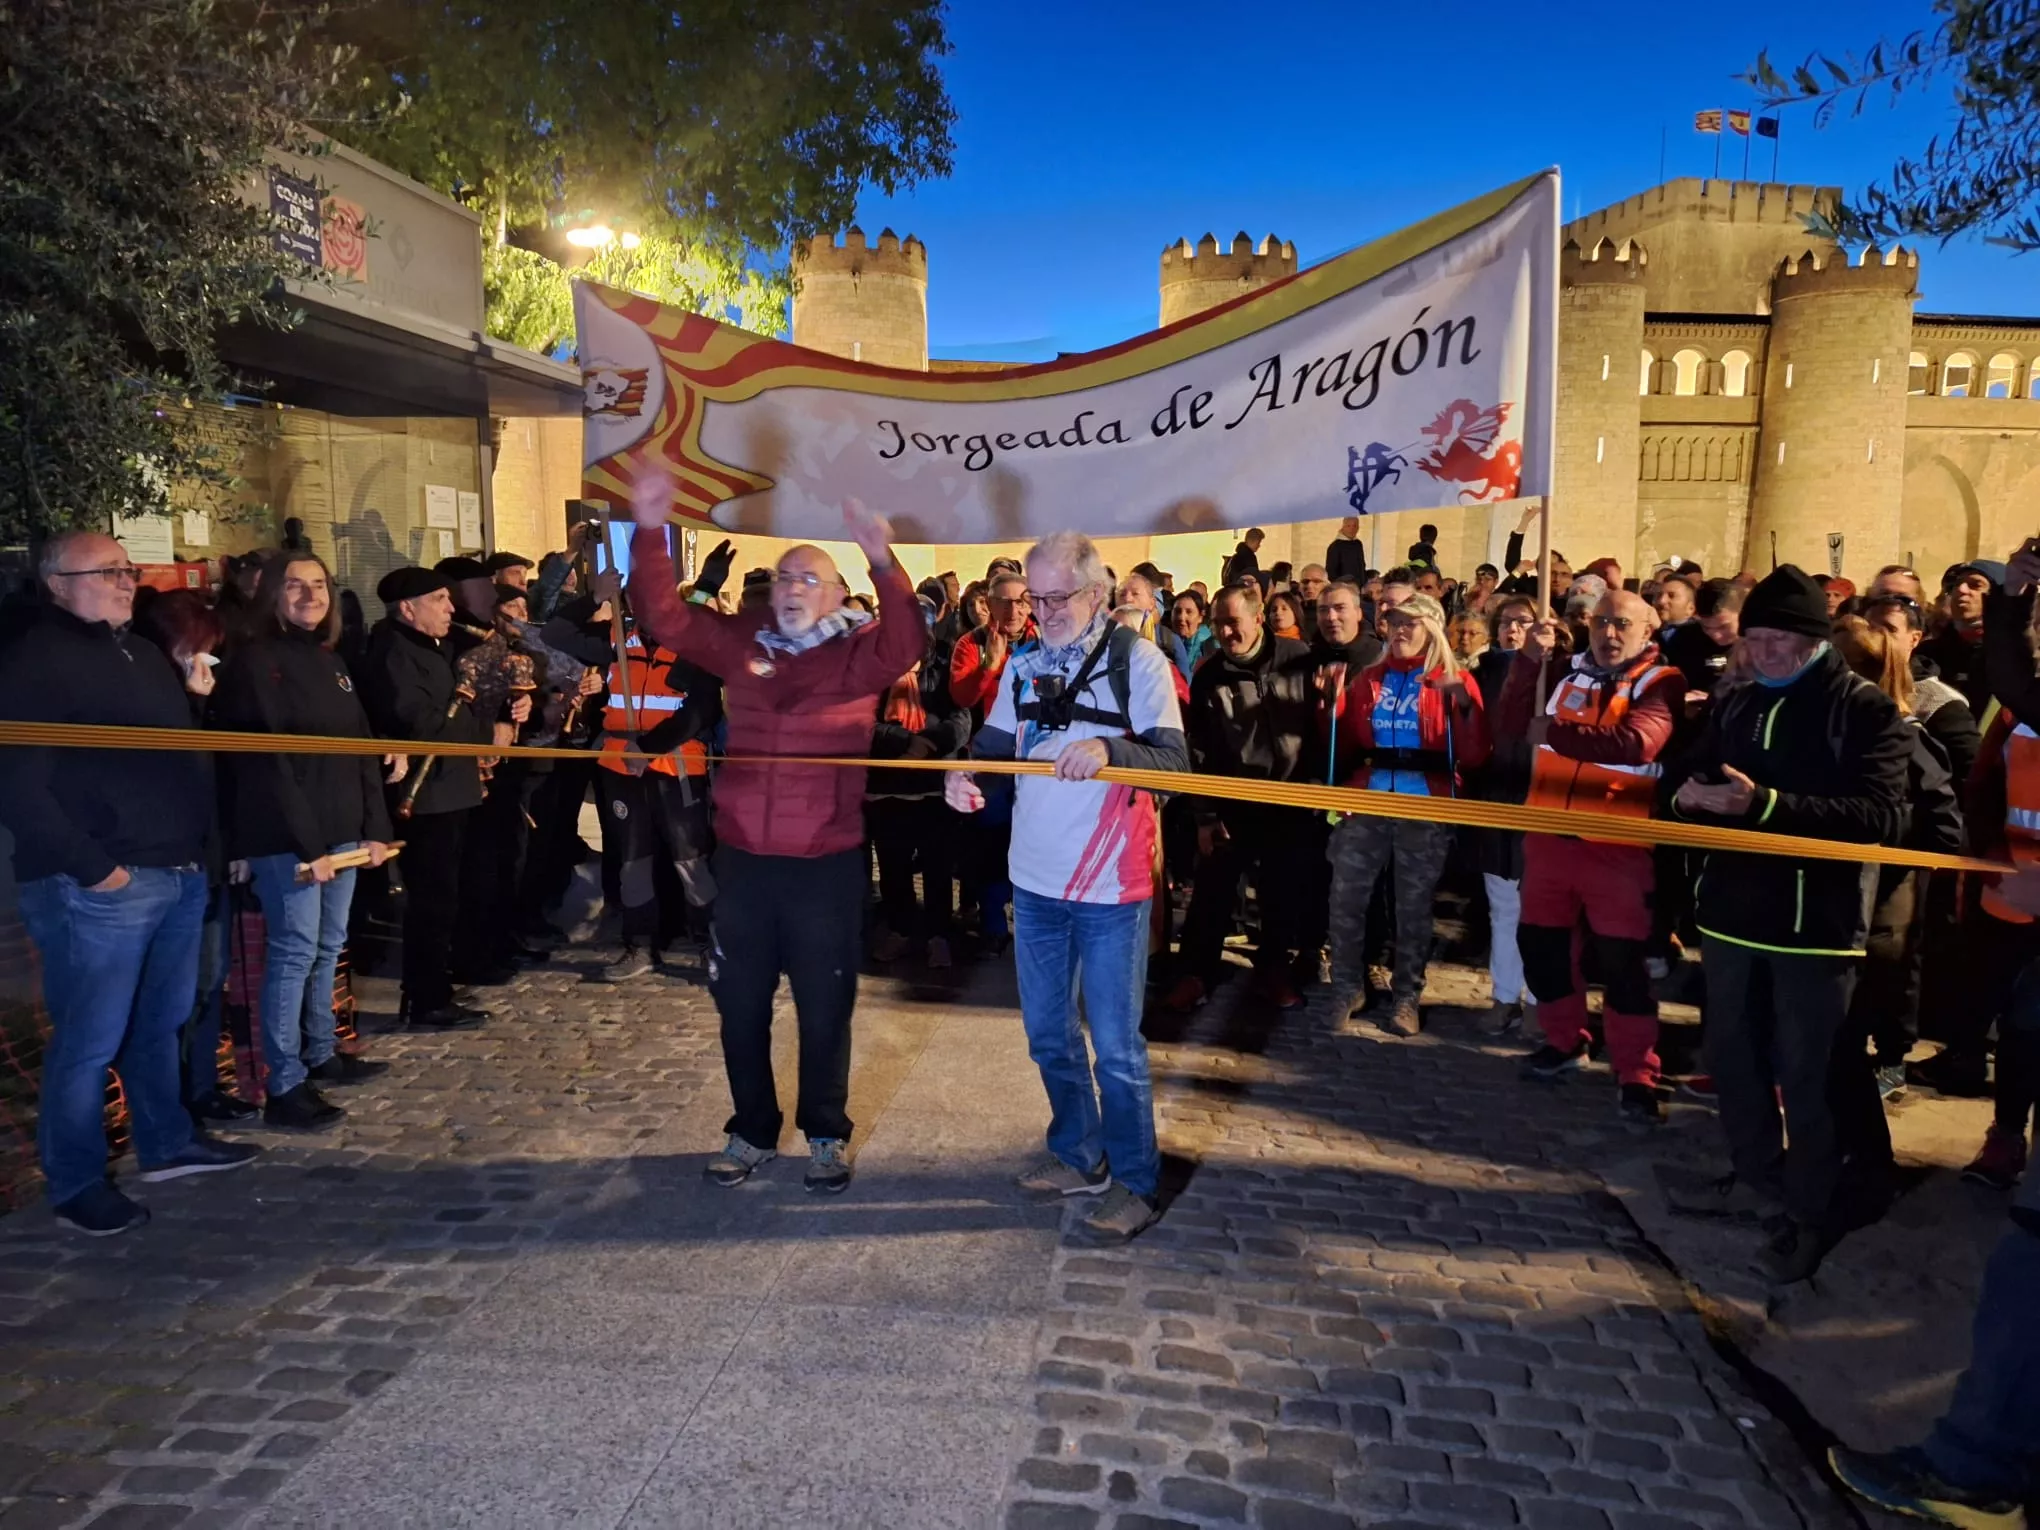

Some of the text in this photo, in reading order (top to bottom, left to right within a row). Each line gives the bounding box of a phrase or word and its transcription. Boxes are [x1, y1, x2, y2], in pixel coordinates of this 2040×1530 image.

[877, 305, 1482, 472] Jorgeada de Aragón
